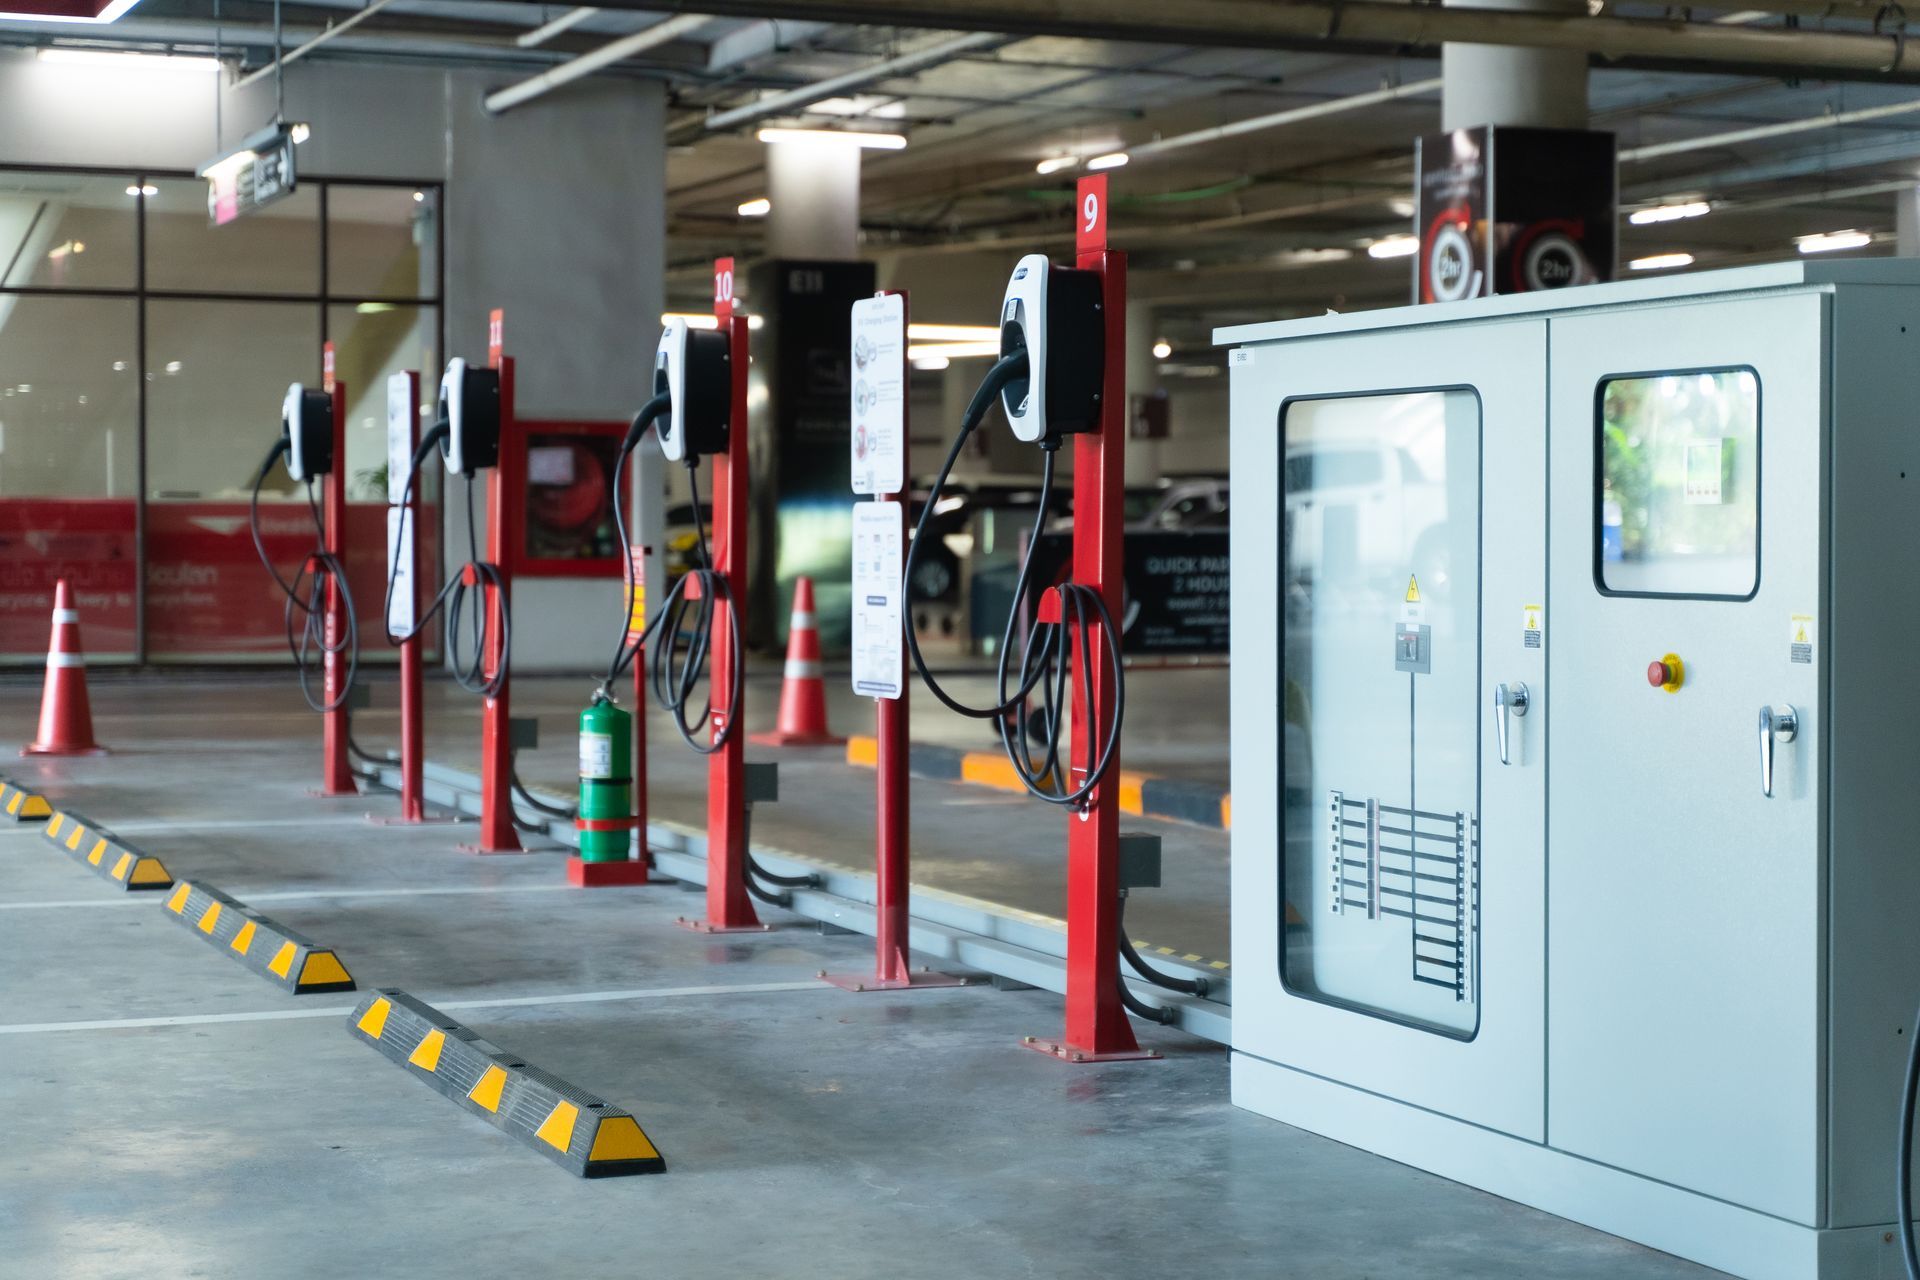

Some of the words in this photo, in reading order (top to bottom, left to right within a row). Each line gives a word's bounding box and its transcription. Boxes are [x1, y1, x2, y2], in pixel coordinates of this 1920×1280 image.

[1085, 193, 1098, 233] 9
[715, 271, 732, 302] 10
[1147, 557, 1197, 574] QUICK
